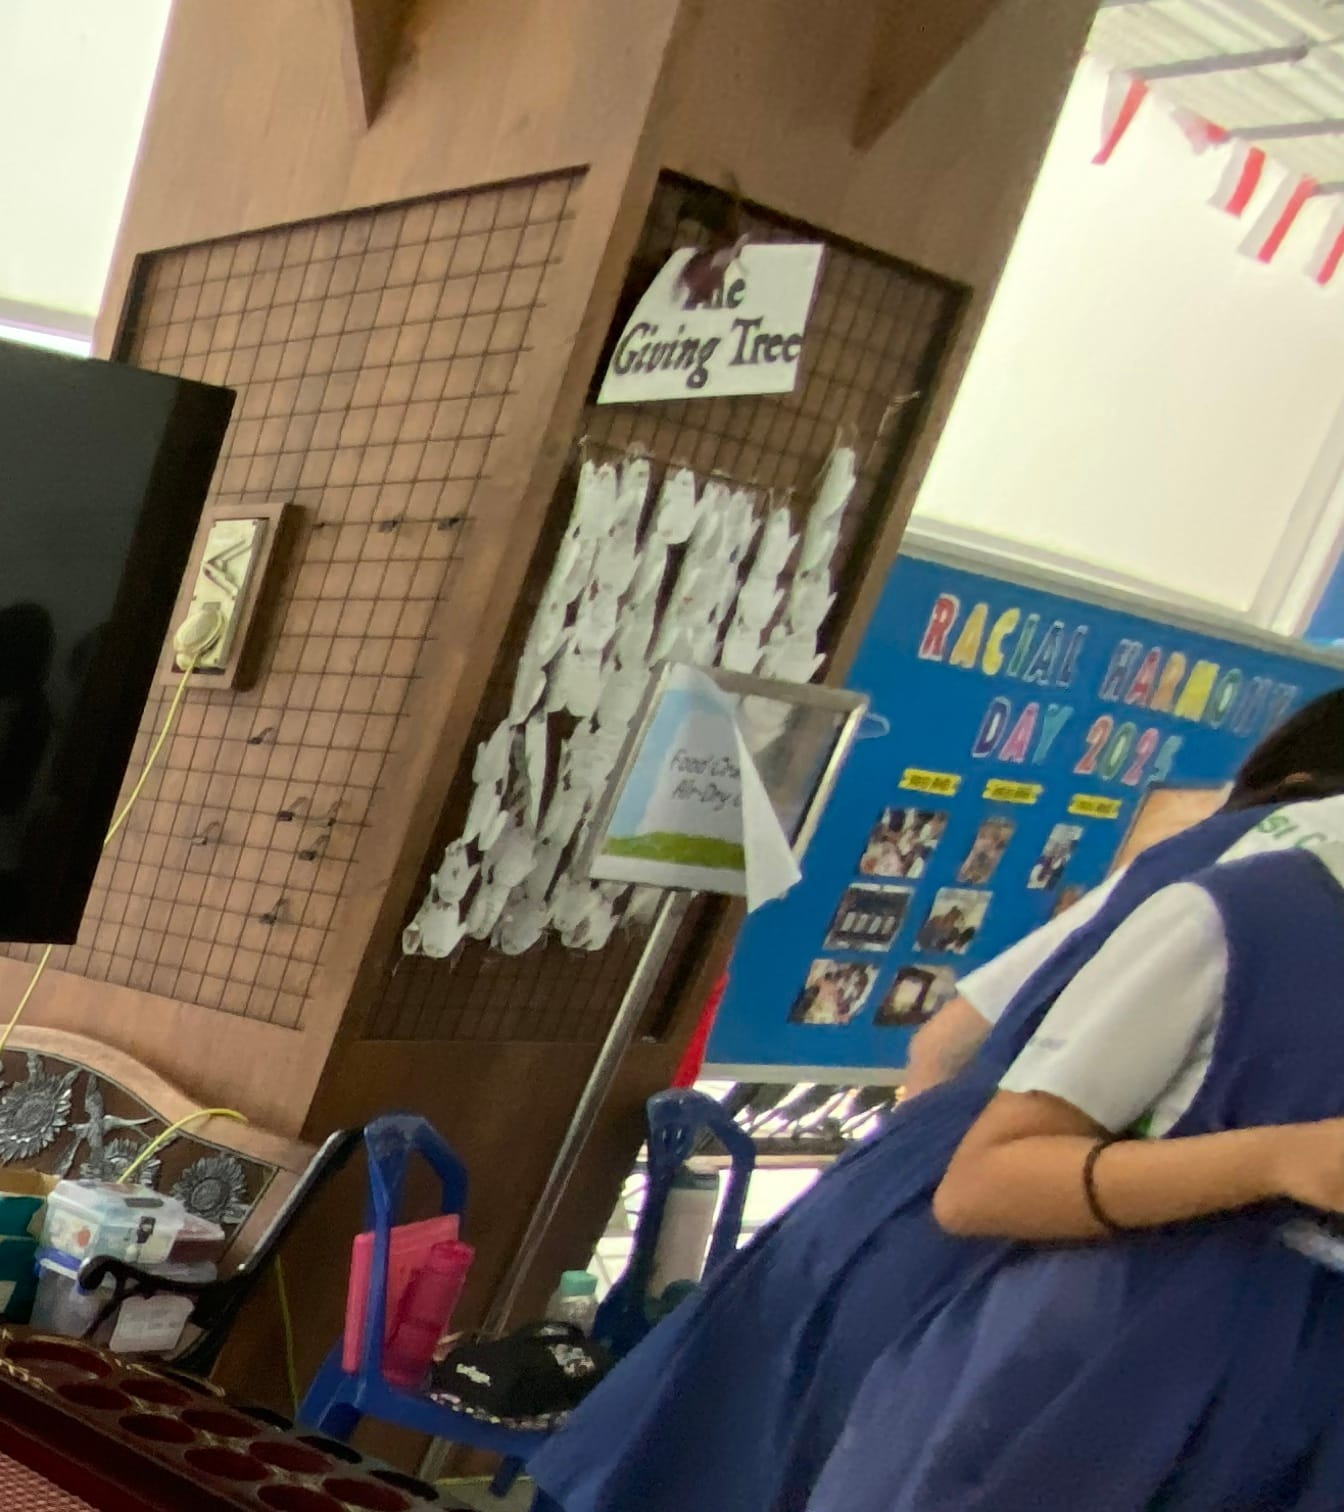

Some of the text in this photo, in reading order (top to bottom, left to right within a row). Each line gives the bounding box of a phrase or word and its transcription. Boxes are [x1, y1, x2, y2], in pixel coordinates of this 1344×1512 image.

[613, 315, 803, 389] Giving Tree
[917, 592, 1089, 689] RACIAL
[970, 695, 1075, 766] DAY
